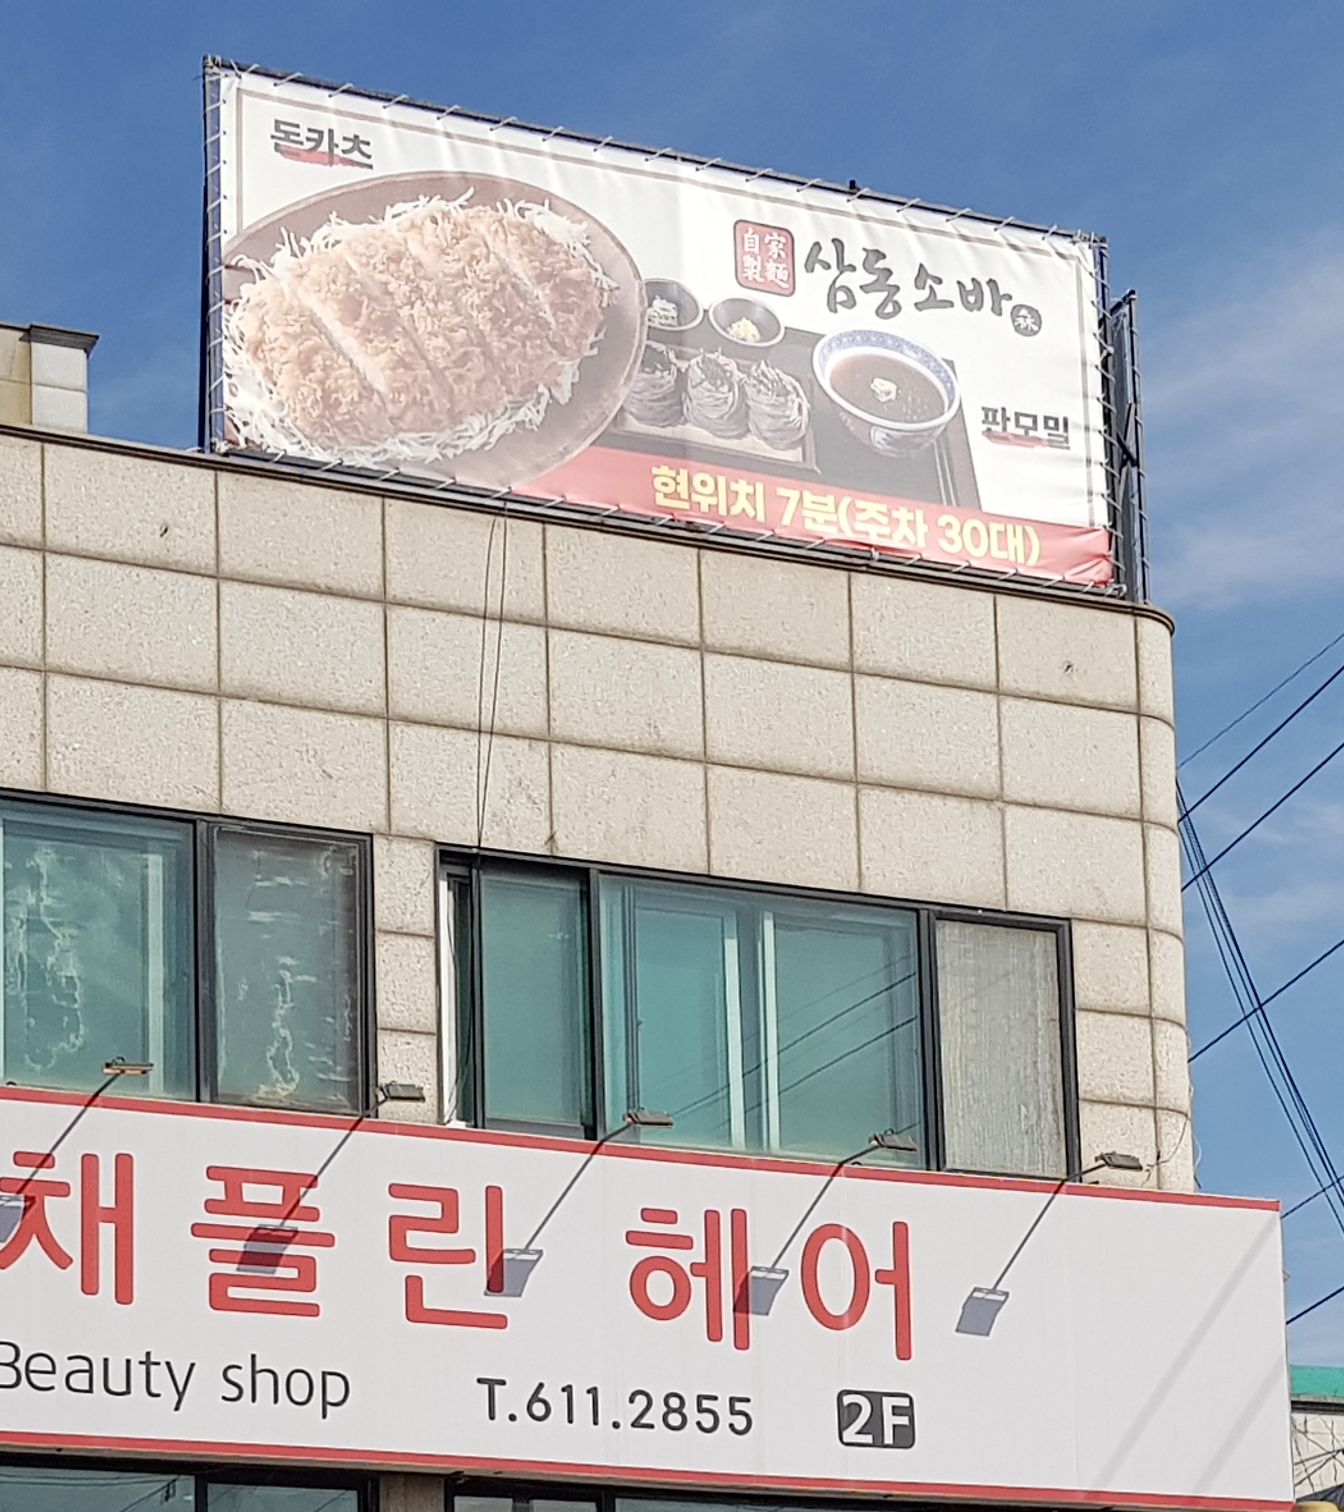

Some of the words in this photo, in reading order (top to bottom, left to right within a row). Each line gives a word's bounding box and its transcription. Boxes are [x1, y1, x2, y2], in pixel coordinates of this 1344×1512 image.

[270, 118, 374, 169] 돈카츠
[981, 406, 1071, 451] 판모밀
[651, 465, 767, 523] 현위치
[775, 486, 929, 549] 7분(주차
[937, 513, 1042, 567] 30대)
[625, 1207, 914, 1362] 헤어
[219, 1353, 353, 1420] shop
[476, 1378, 754, 1437] T.611.2855
[839, 1391, 915, 1449] 2F
